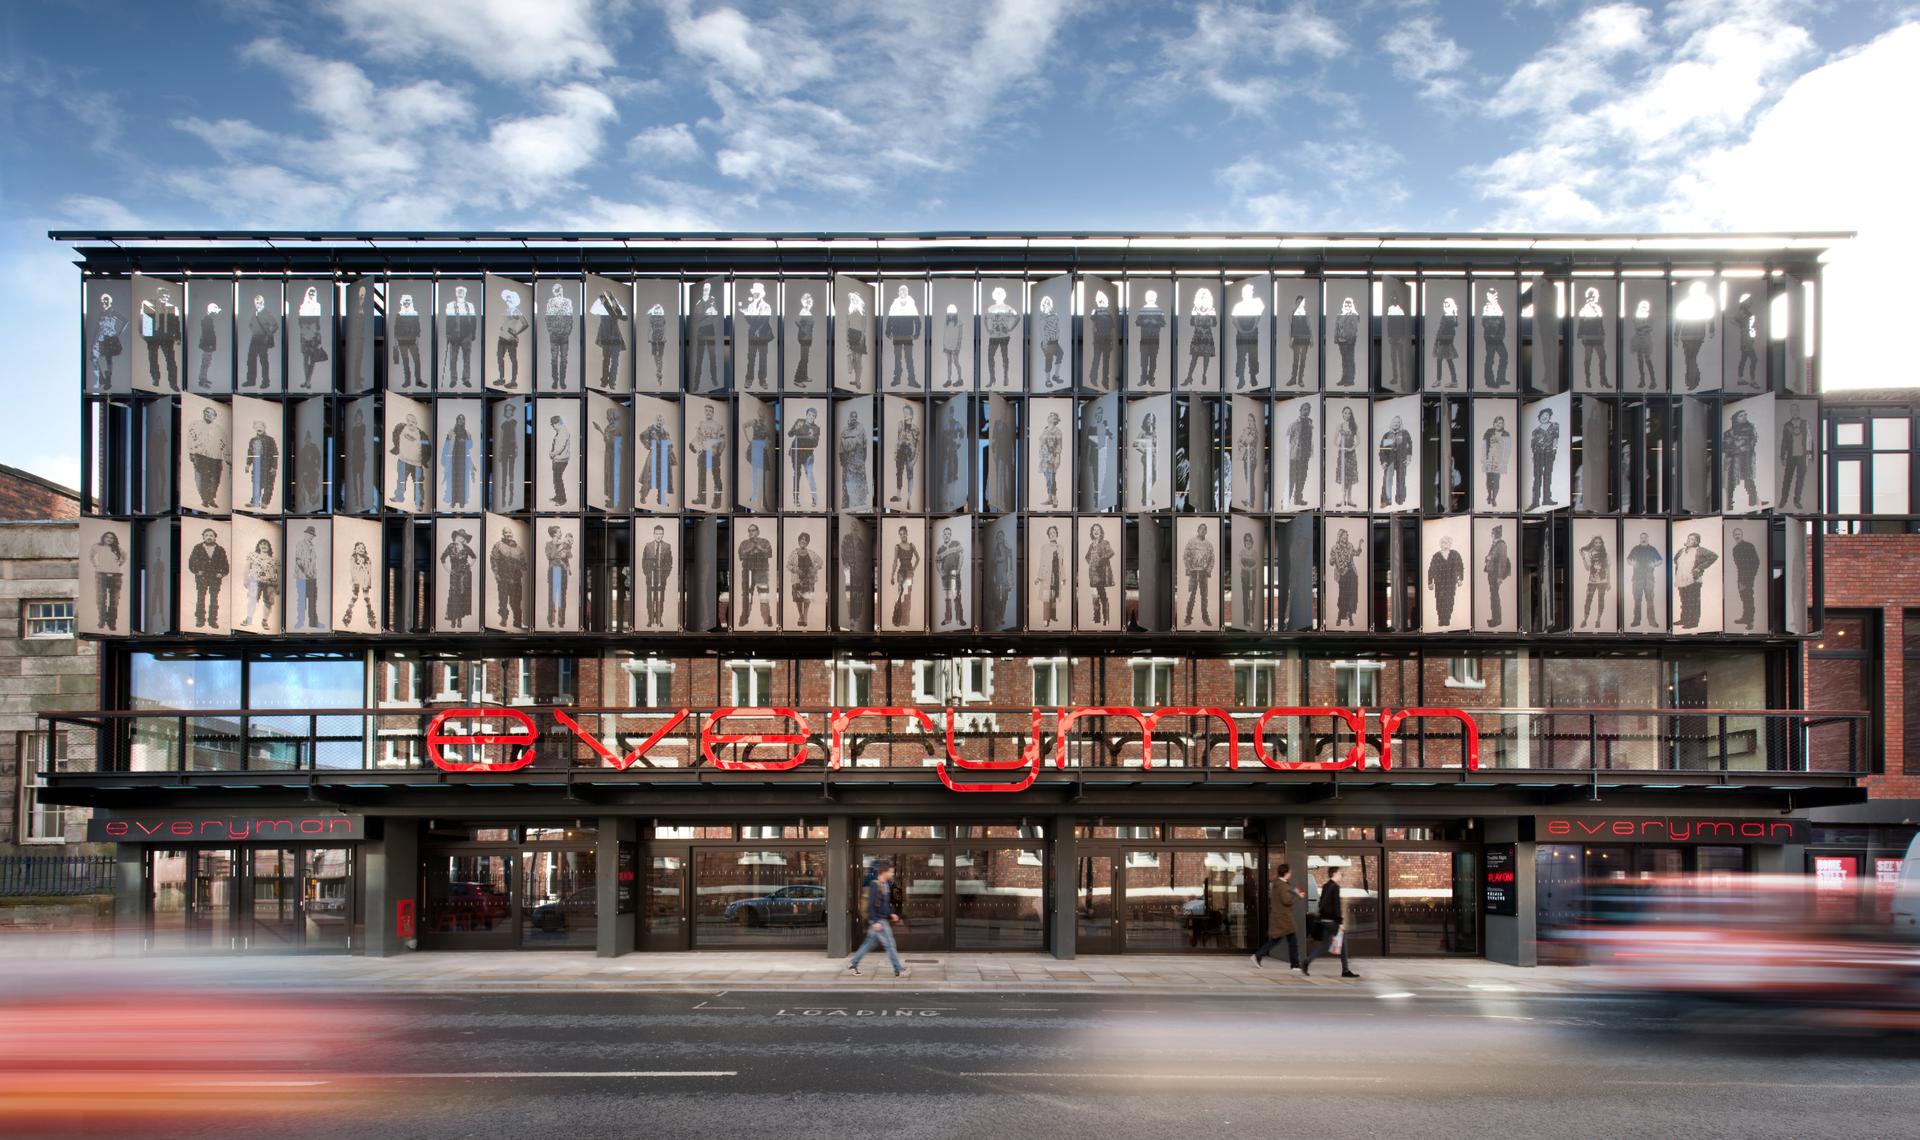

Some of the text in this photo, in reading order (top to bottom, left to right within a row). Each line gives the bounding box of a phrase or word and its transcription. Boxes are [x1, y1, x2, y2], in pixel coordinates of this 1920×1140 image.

[427, 707, 1479, 792] everyman
[105, 819, 353, 840] everyman
[1548, 821, 1793, 841] everyman
